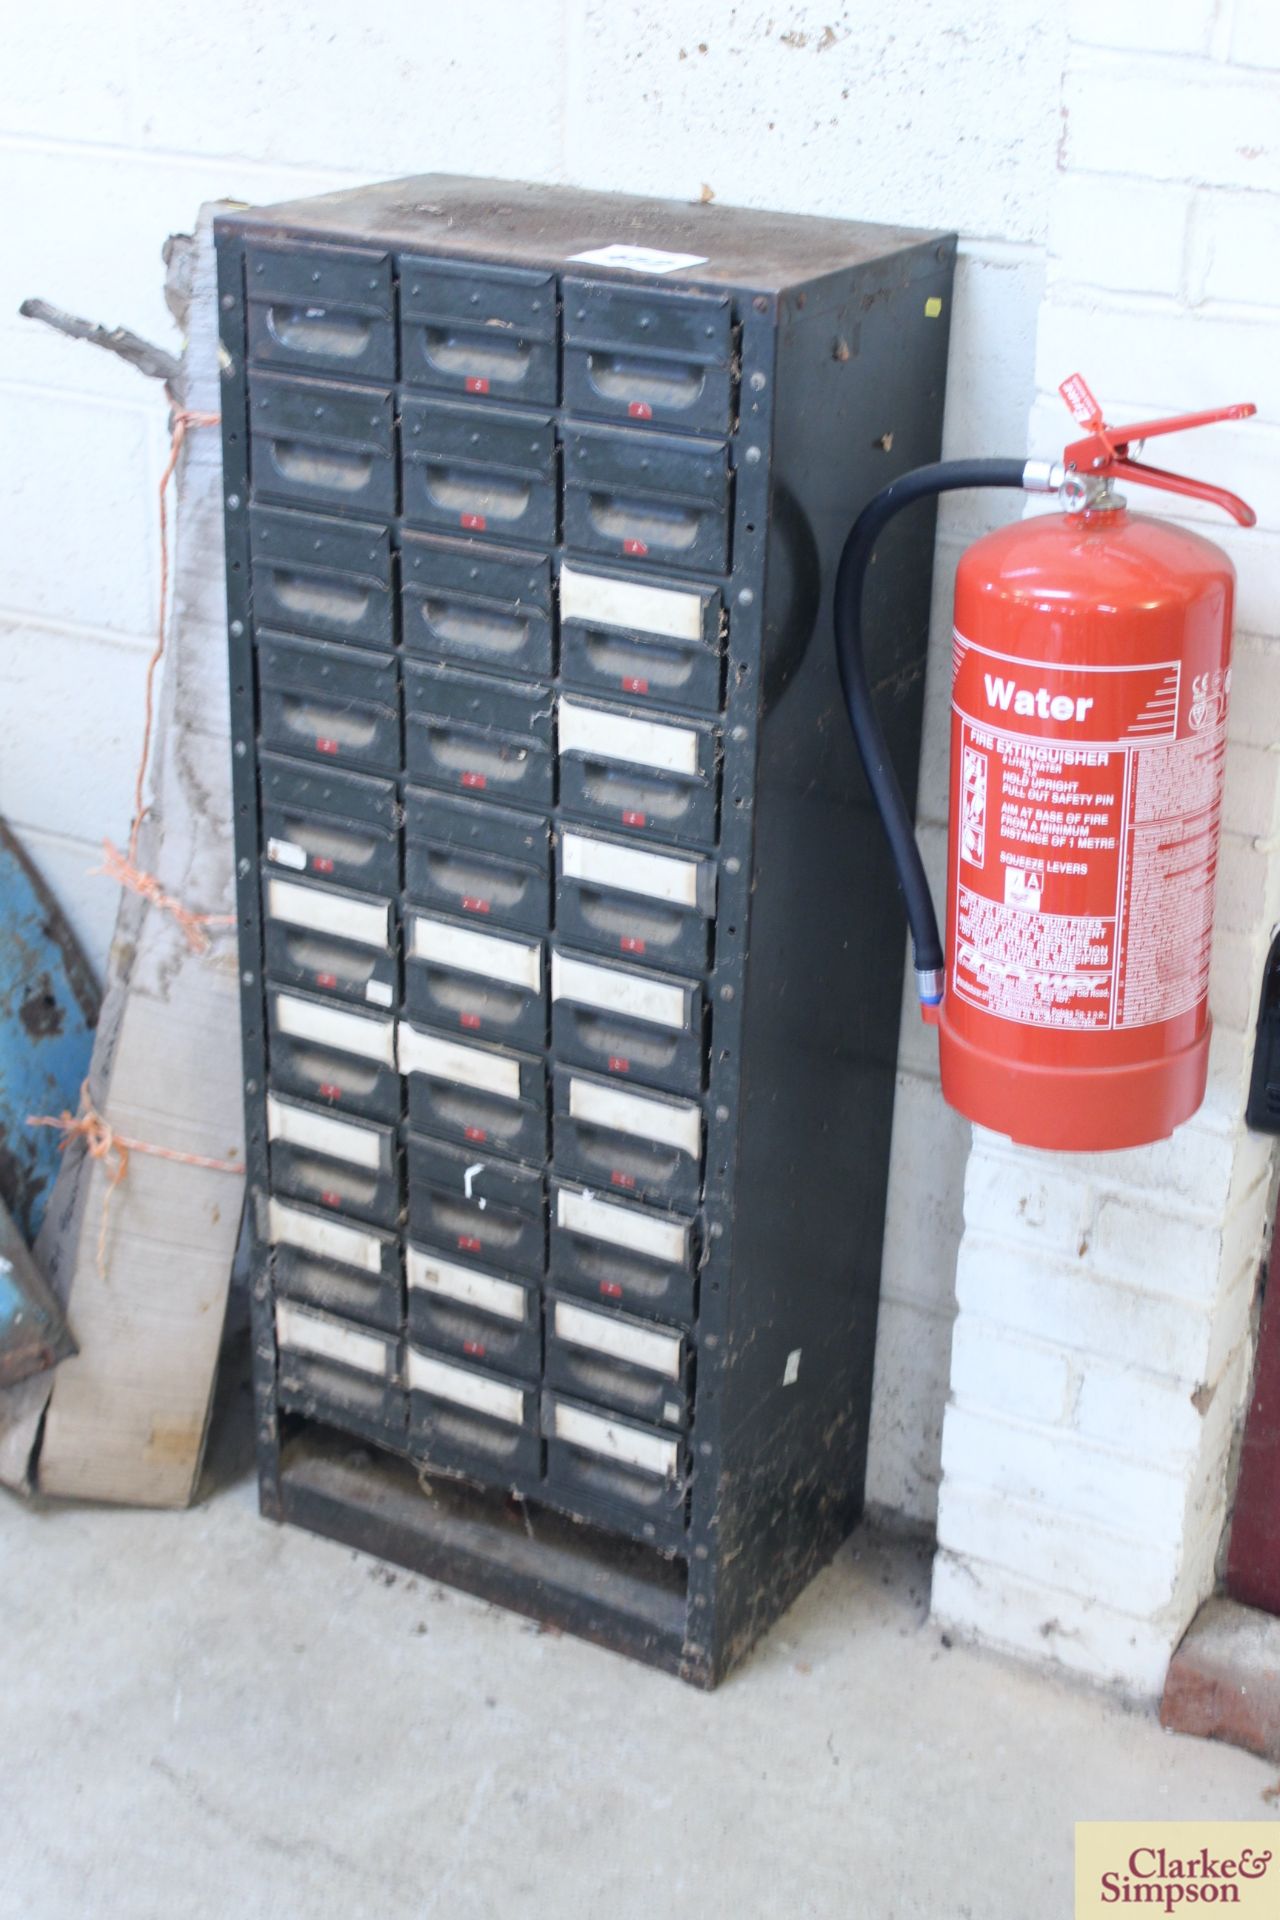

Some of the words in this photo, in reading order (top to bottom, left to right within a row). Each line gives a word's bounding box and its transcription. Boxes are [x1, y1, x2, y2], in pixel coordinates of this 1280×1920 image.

[984, 673, 1094, 722] Water
[970, 727, 993, 750] FIRE
[996, 739, 1108, 766] EXTINGUISHER
[1009, 757, 1030, 770] LITRE
[1033, 762, 1062, 774] WATER
[1003, 771, 1028, 786] HOLD
[1032, 777, 1078, 793] UPRIGHT
[1002, 783, 1025, 798] PULL
[1028, 789, 1049, 802] OUT
[1052, 793, 1092, 806] SAFETY
[1095, 795, 1114, 806] PIN
[1001, 801, 1018, 815] AIM
[1020, 807, 1033, 819] AT
[1036, 809, 1063, 824] BASE
[1066, 813, 1081, 824] OF
[1084, 814, 1108, 825] FIRE
[1001, 815, 1028, 829] FROM
[1030, 822, 1037, 831] A
[1040, 823, 1089, 837] MINIMUM
[1001, 826, 1048, 845] DISTANCE
[1052, 835, 1066, 846] OF
[1070, 837, 1074, 847] 1
[1078, 838, 1115, 849] METRE
[1000, 851, 1044, 870] SQUEEZE
[1047, 861, 1088, 875] LEVERS
[1027, 872, 1039, 888] A
[1033, 933, 1089, 946] PRESSURE
[1044, 924, 1106, 938] EQUIPMENT
[1052, 953, 1107, 964] SPECIFIED
[1061, 944, 1107, 954] SECTION
[1038, 959, 1075, 972] RANGE
